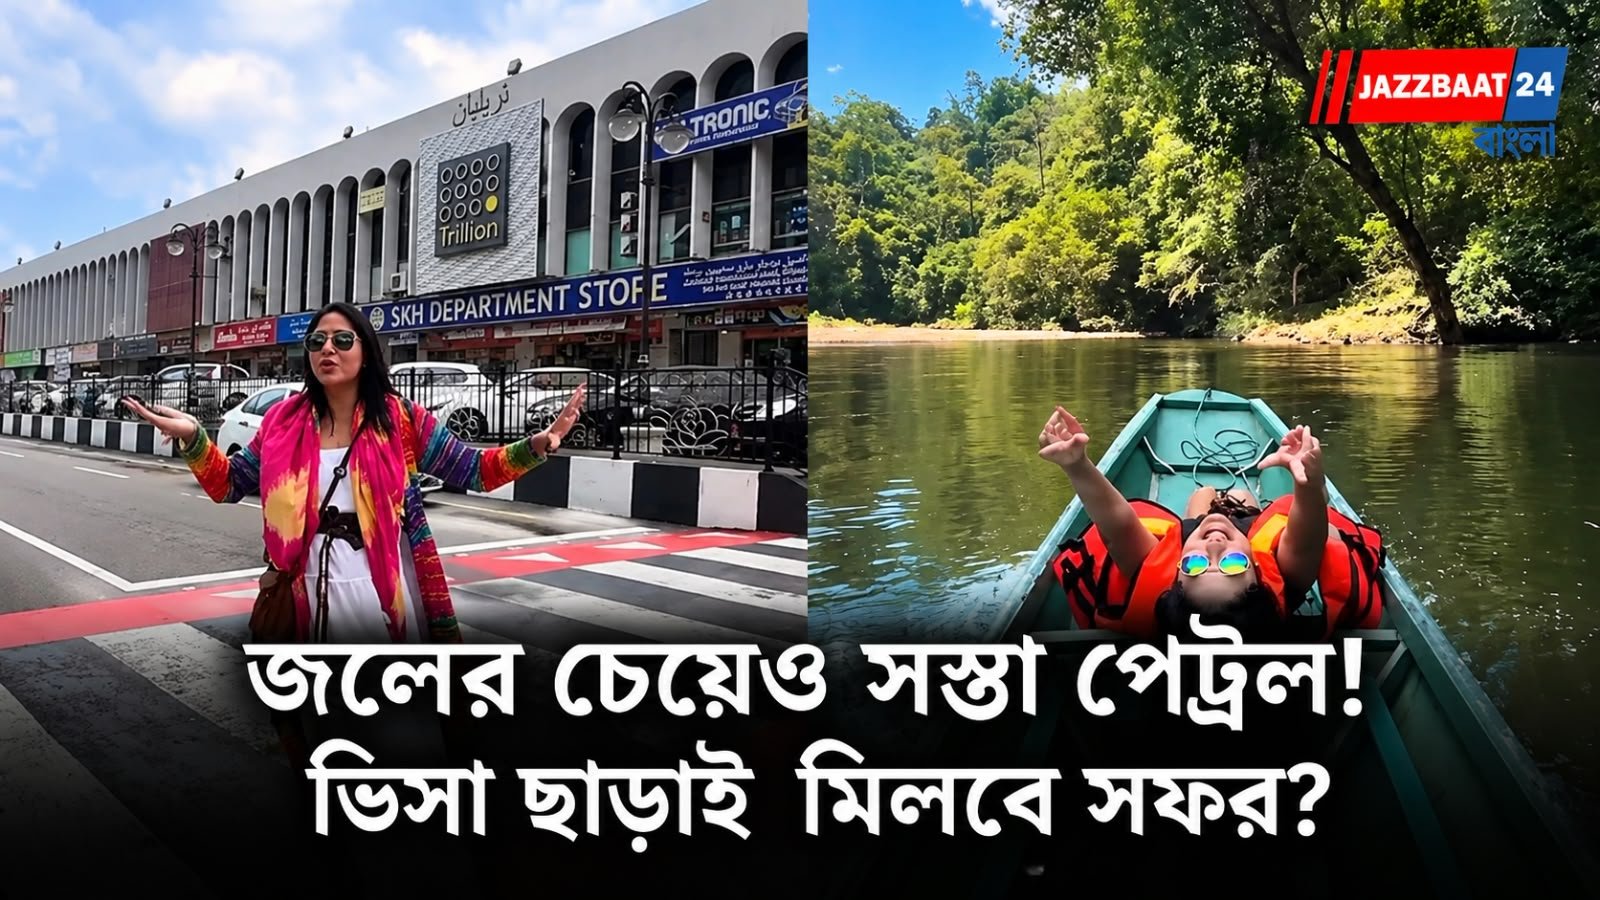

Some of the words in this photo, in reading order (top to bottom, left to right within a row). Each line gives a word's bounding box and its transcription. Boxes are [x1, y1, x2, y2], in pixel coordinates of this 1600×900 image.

[439, 220, 498, 248] Trillion
[391, 303, 423, 328] SKH
[430, 284, 571, 323] DEPARTMENT
